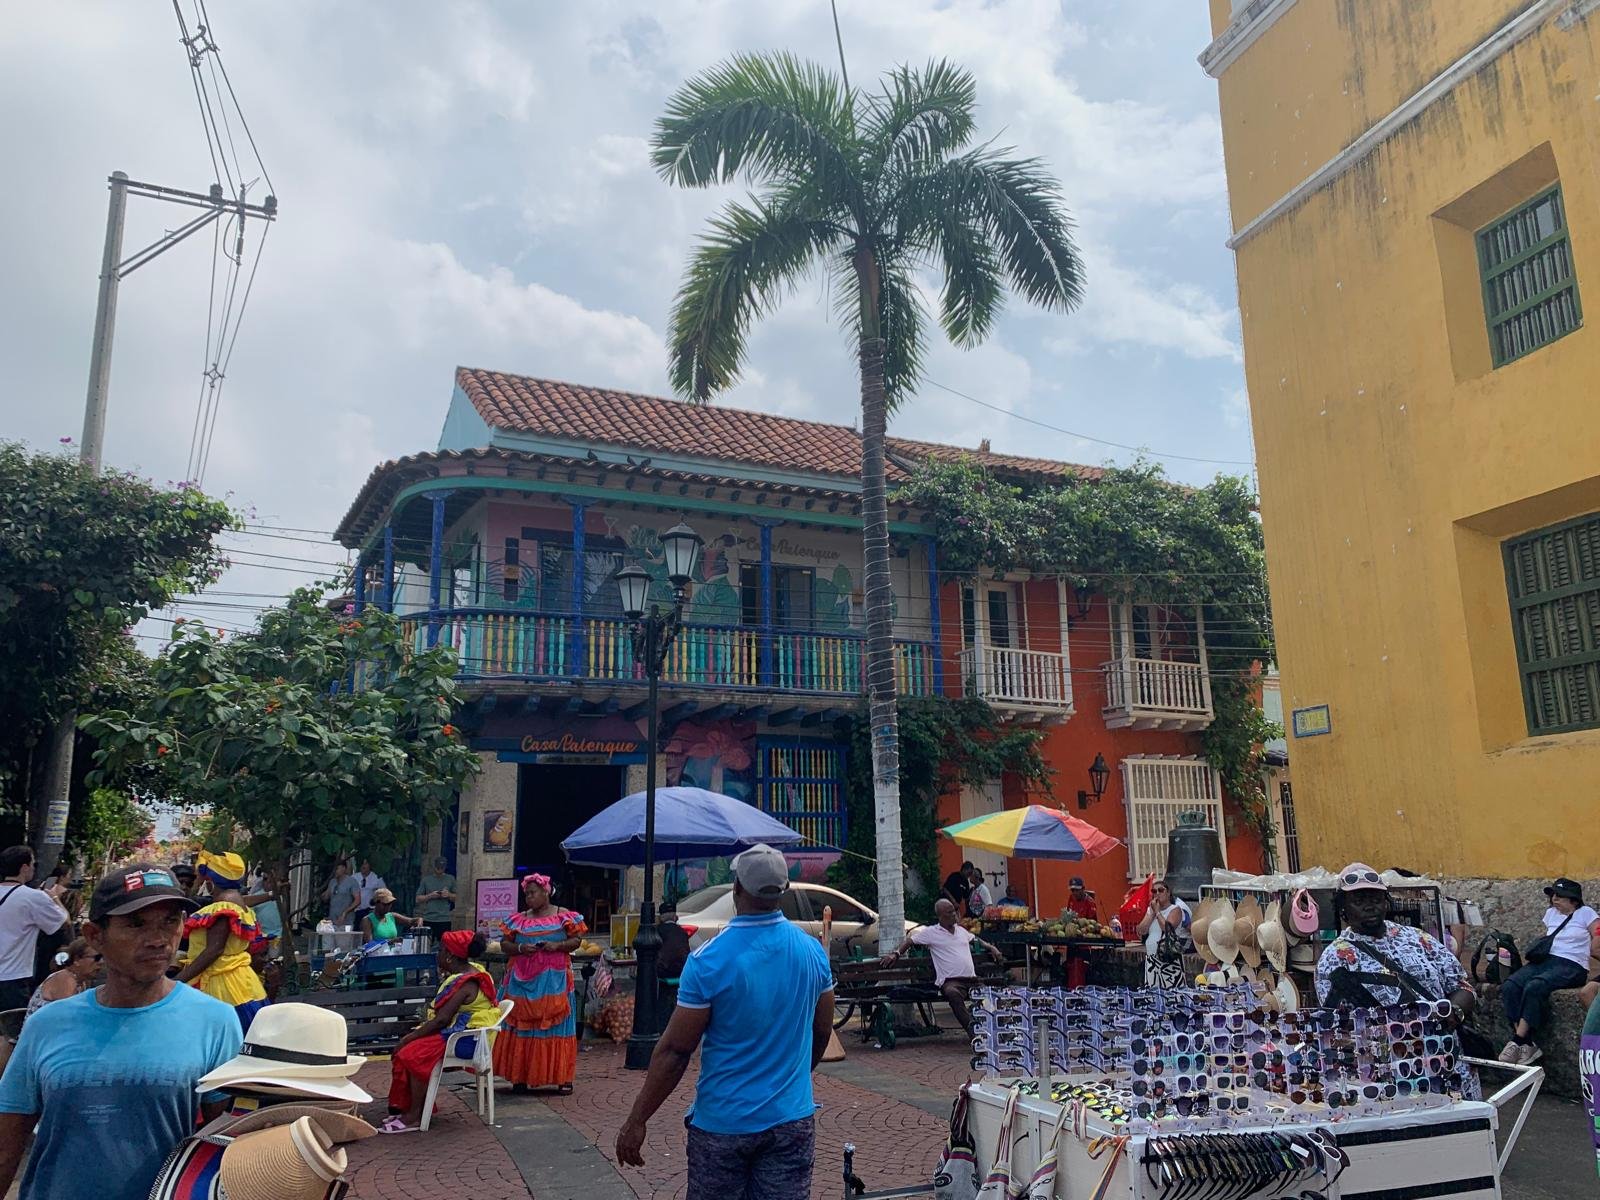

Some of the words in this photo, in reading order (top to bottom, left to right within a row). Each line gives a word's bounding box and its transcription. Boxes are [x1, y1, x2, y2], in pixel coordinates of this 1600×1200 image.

[745, 536, 778, 552] Caa
[777, 538, 840, 564] Palenque
[521, 735, 560, 753] Casa
[560, 733, 638, 758] Palenque
[483, 893, 512, 906] 3X2
